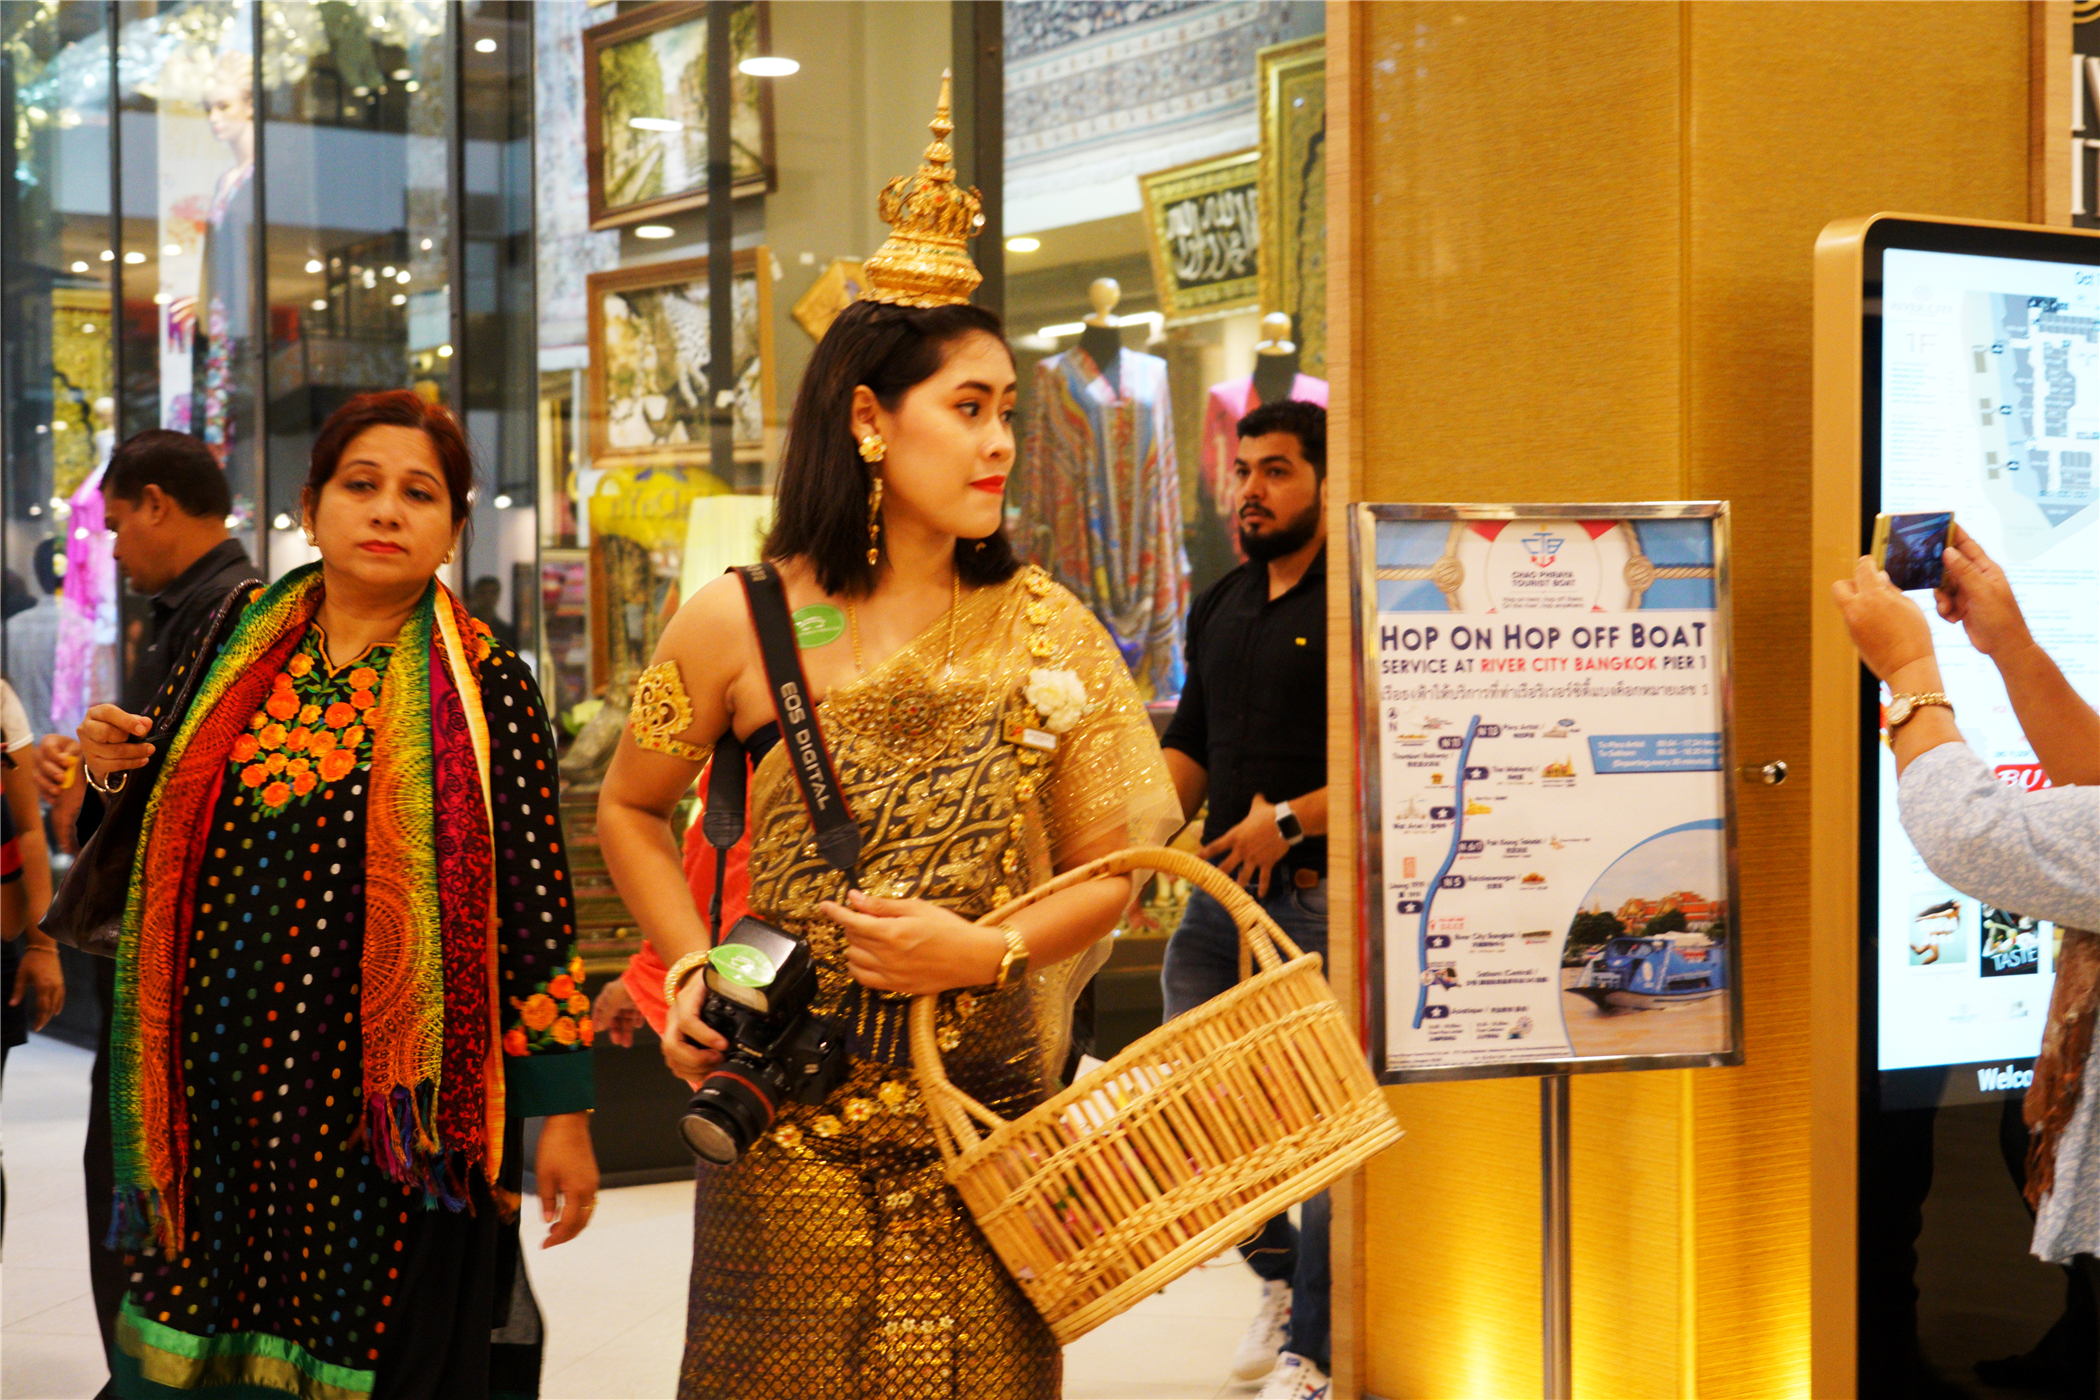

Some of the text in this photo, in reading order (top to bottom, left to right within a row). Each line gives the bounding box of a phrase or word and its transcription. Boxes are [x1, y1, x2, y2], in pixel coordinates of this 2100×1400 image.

[1905, 332, 1939, 354] 1F
[1511, 579, 1576, 587] TOURIST BOAT
[1381, 622, 1706, 651] HOP ON HOP OFF BOAT
[1382, 655, 1707, 674] SERVICE AT RIVER CITY BANGKOK PIER 1
[1702, 683, 1710, 696] 1
[780, 681, 832, 811] EOS DIGITAL
[1996, 769, 2052, 790] BU
[1991, 945, 2038, 971] TASTE
